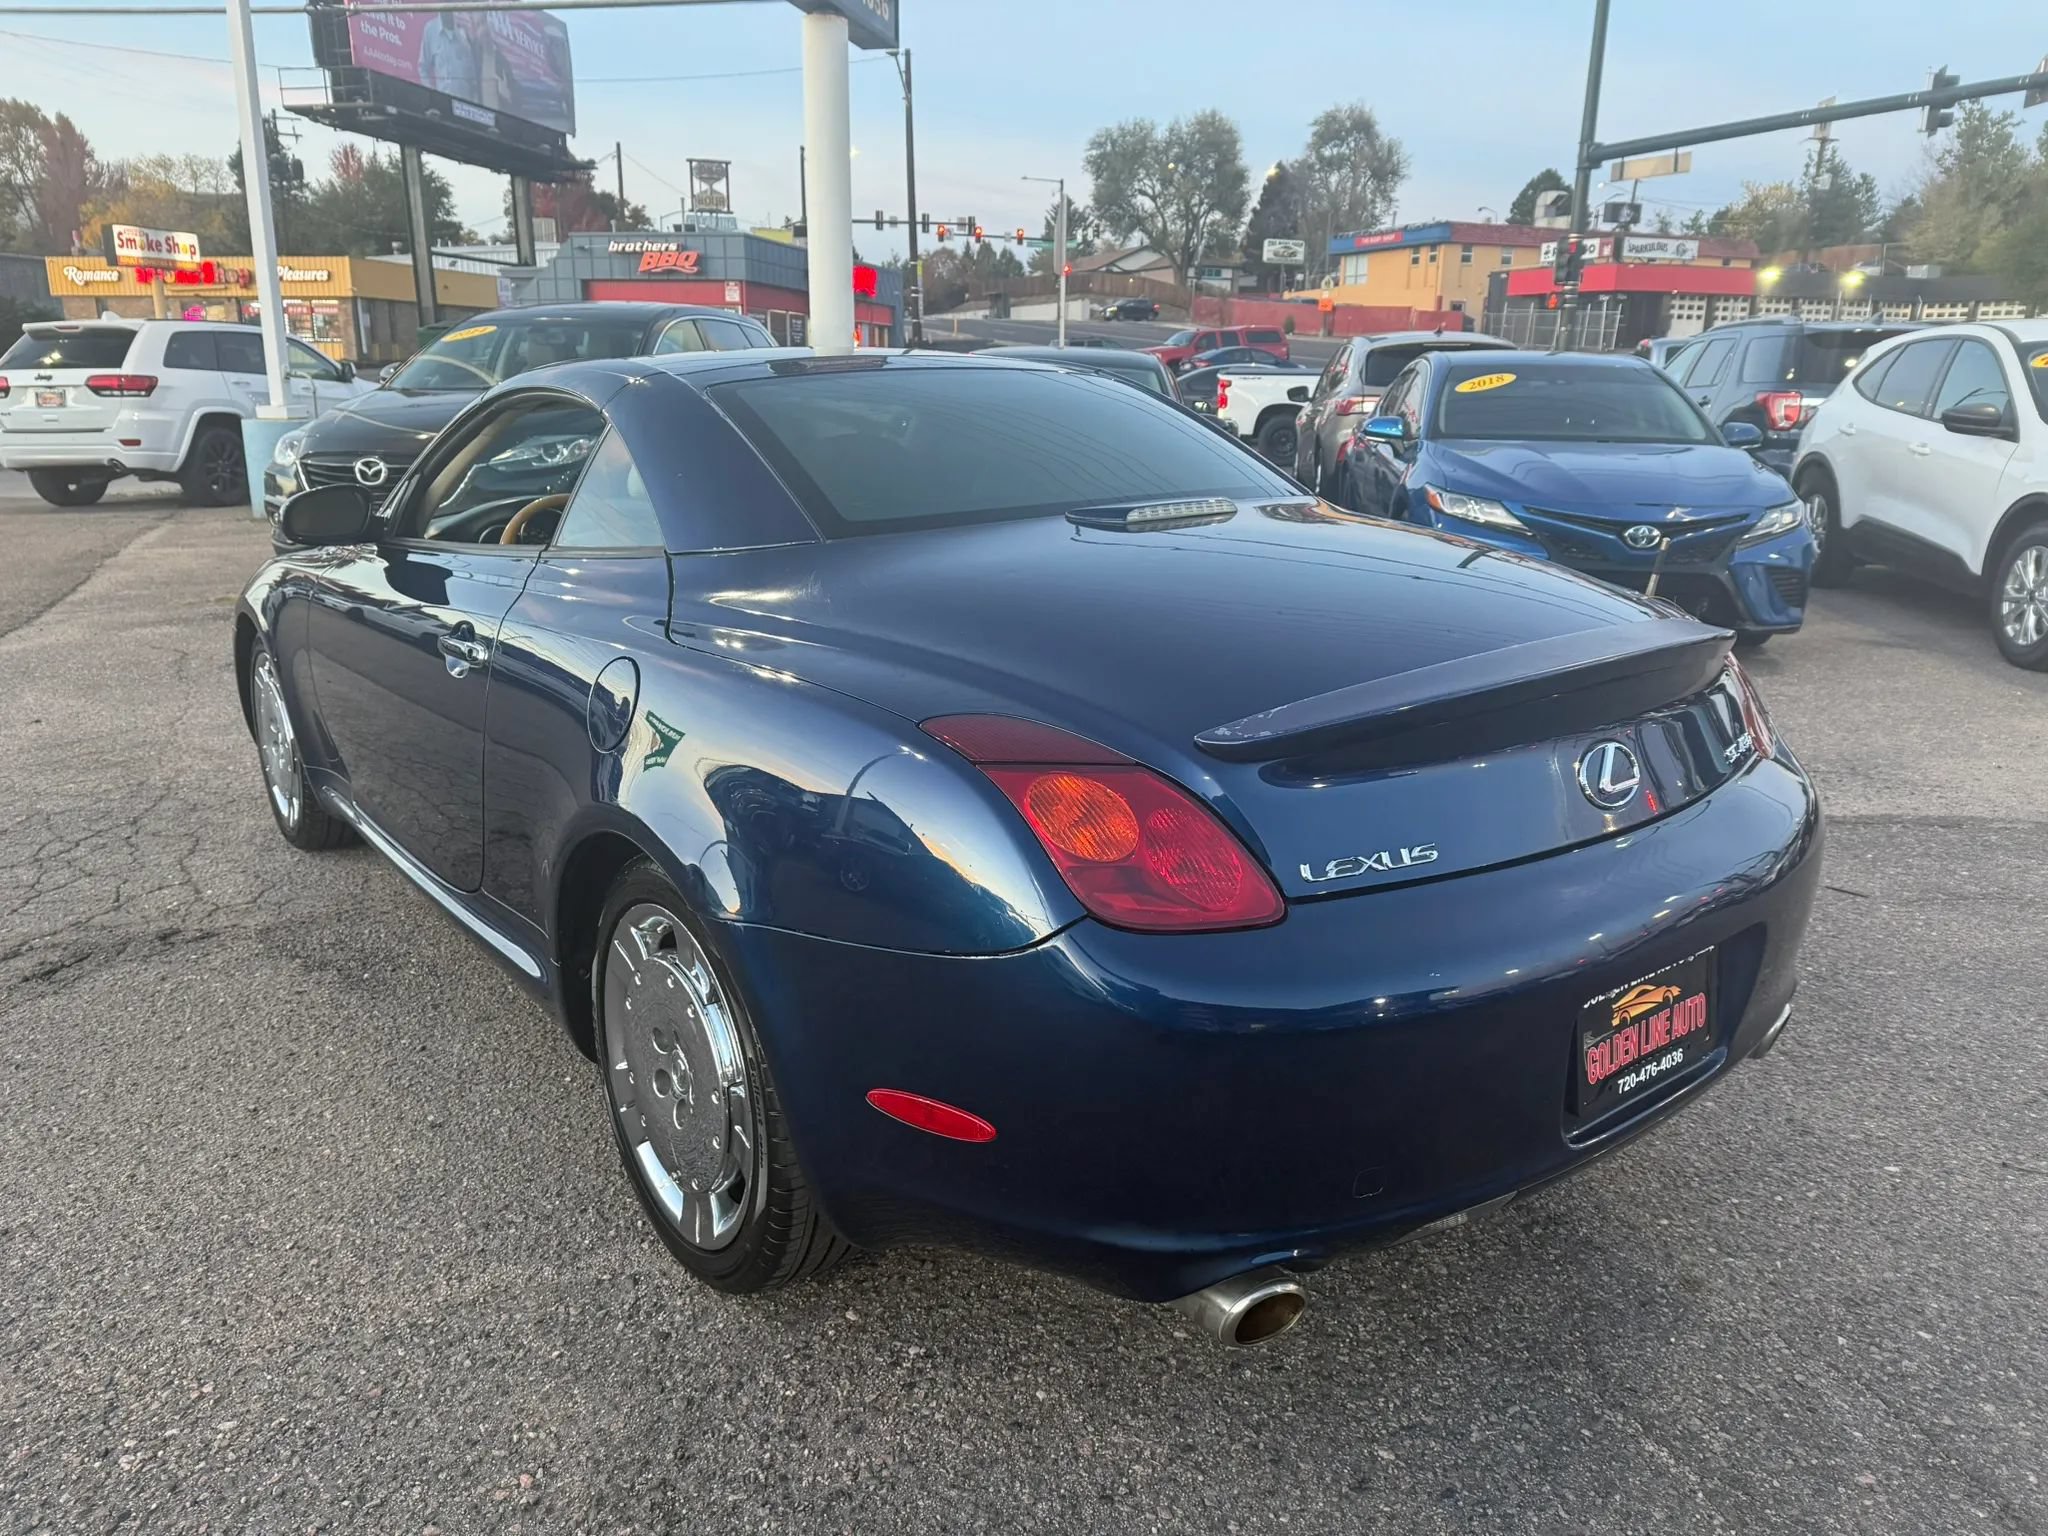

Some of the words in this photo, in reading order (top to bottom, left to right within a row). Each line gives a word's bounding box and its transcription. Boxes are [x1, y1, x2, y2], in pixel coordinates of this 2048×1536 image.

[360, 20, 378, 37] the
[396, 16, 406, 31] to
[116, 231, 163, 253] Smoke
[165, 235, 197, 260] Shop
[608, 240, 678, 252] brothers
[276, 265, 329, 281] Pleasures
[638, 251, 700, 273] BBQ
[63, 265, 120, 287] Romance
[1469, 374, 1505, 390] 2018
[1299, 842, 1439, 882] LEXUS
[1587, 1022, 1639, 1085] GOLDEN
[1640, 1007, 1671, 1055] LINE
[1671, 992, 1706, 1040] AUTO
[1617, 1048, 1684, 1095] 720-476-4036
